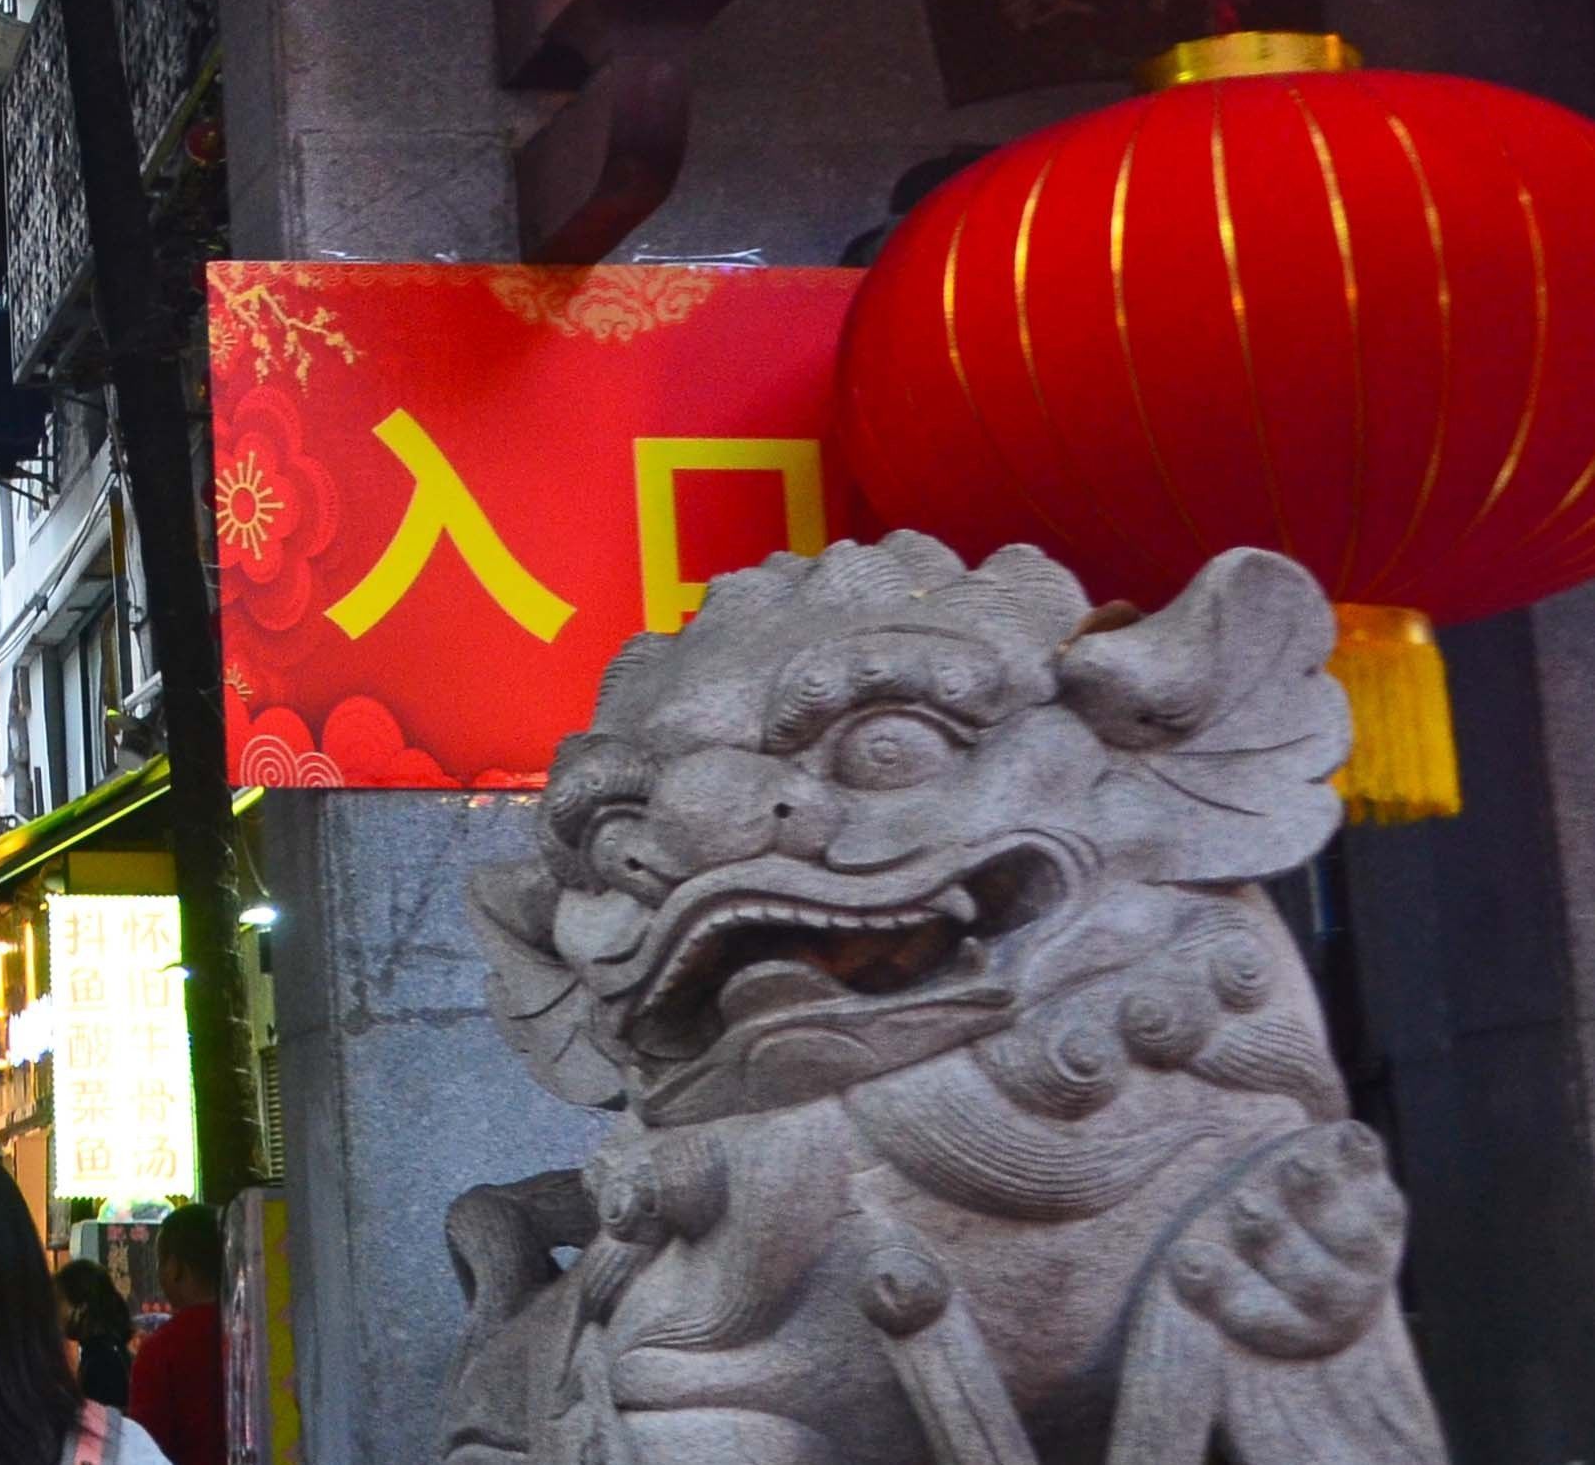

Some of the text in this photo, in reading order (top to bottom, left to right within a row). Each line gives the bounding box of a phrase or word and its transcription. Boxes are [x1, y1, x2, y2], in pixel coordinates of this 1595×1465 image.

[323, 407, 828, 644] 入口
[65, 909, 119, 1182] 抖鱼酸菜鱼
[123, 909, 177, 1181] 怀旧牛骨汤
